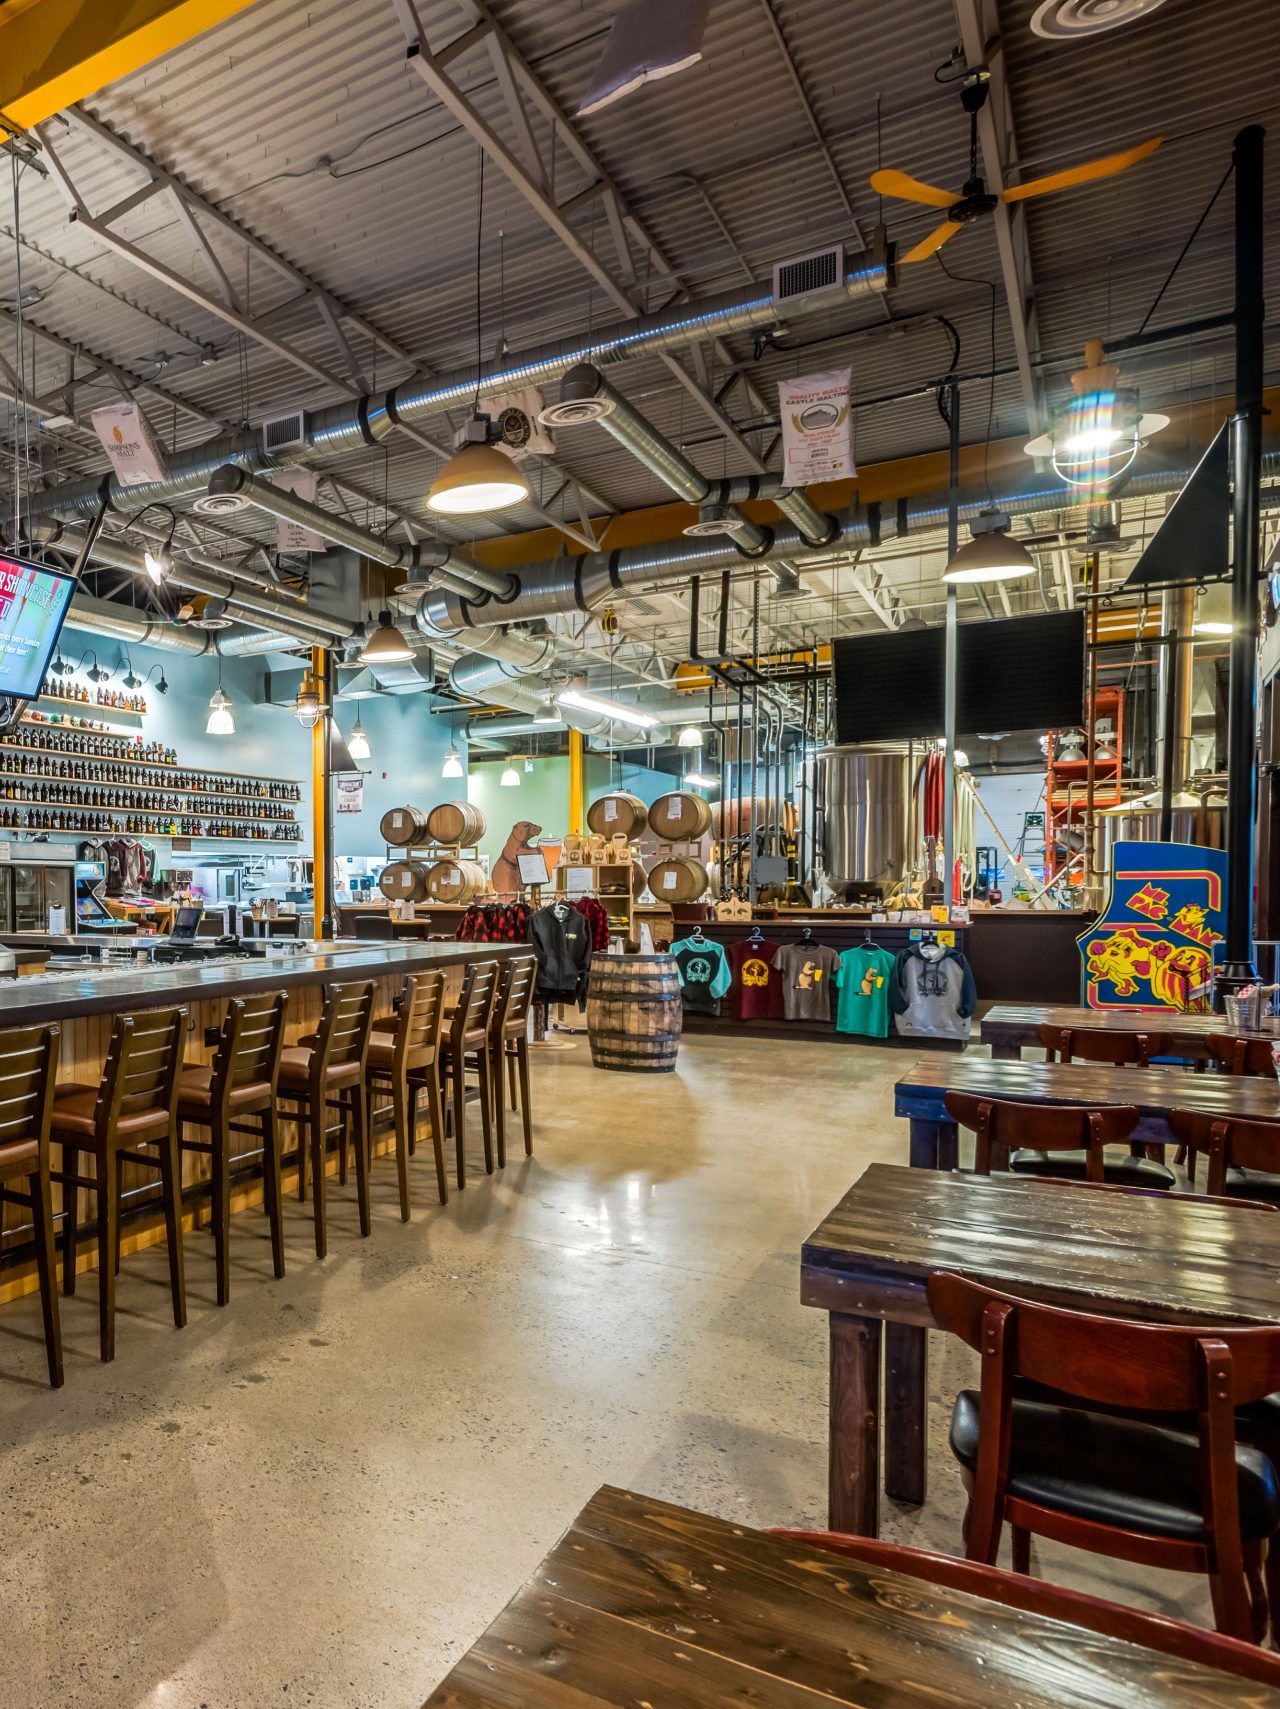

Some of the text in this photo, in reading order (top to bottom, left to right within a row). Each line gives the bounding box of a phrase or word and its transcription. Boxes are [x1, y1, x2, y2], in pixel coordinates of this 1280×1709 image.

[107, 442, 141, 453] SIMPSONS
[117, 449, 135, 457] MALT
[5, 575, 54, 608] SHOWCASE
